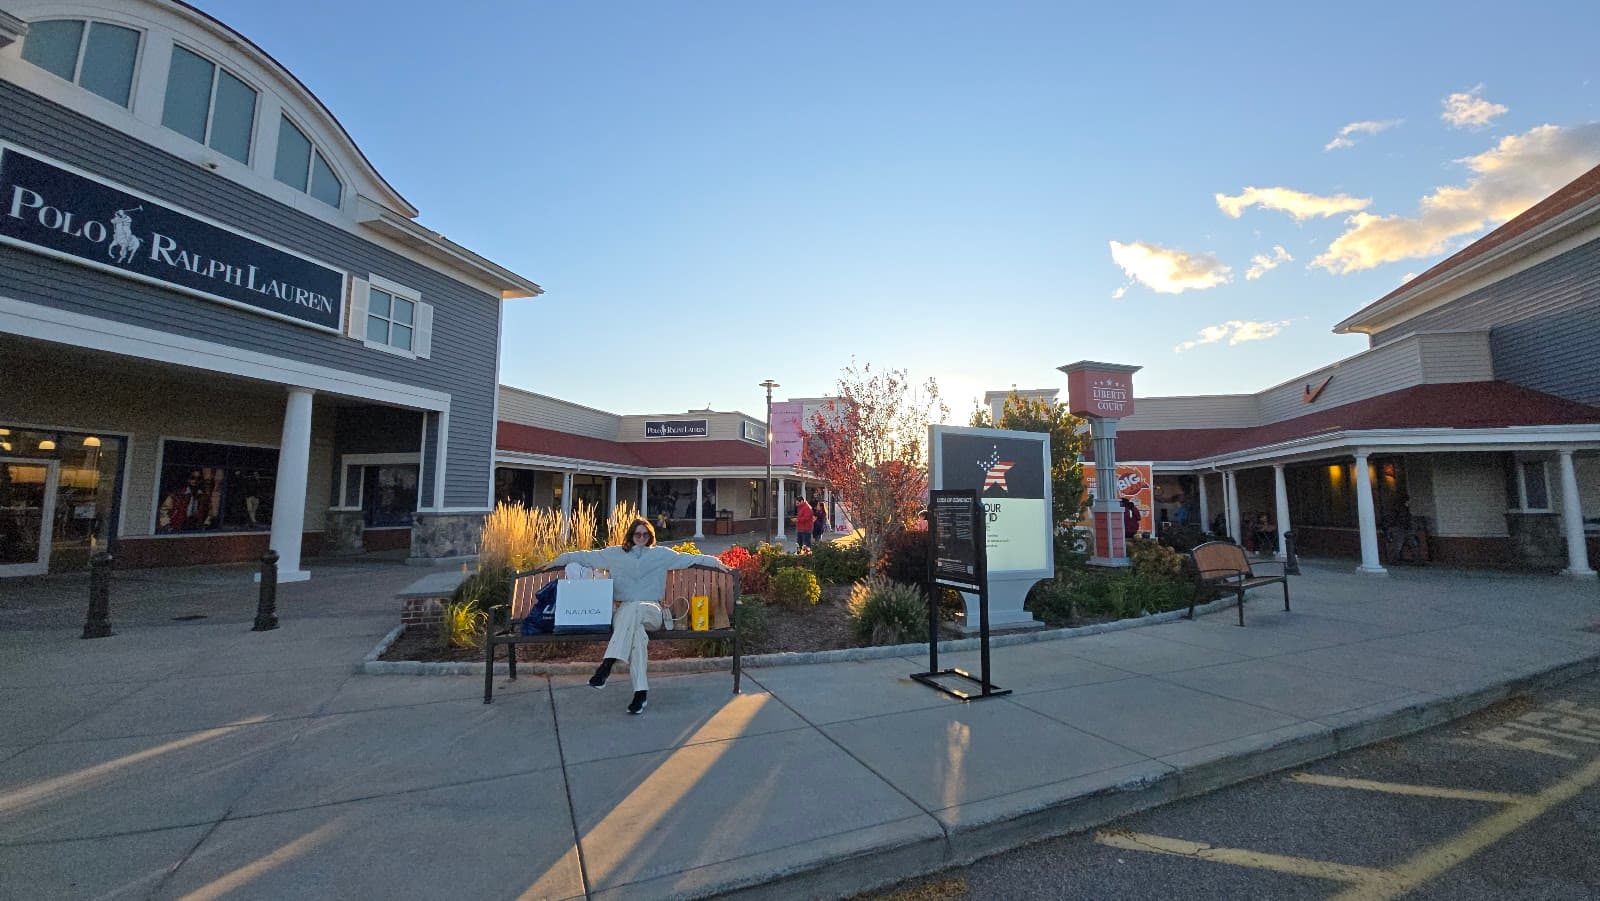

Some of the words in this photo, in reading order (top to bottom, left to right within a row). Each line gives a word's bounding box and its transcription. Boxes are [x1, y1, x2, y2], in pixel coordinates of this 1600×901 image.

[7, 184, 107, 243] POLO
[151, 232, 242, 287] RALPH
[247, 264, 333, 315] LAUREN
[1093, 389, 1127, 400] LIBERTY
[1097, 402, 1124, 412] COURT
[984, 503, 1001, 513] OUR
